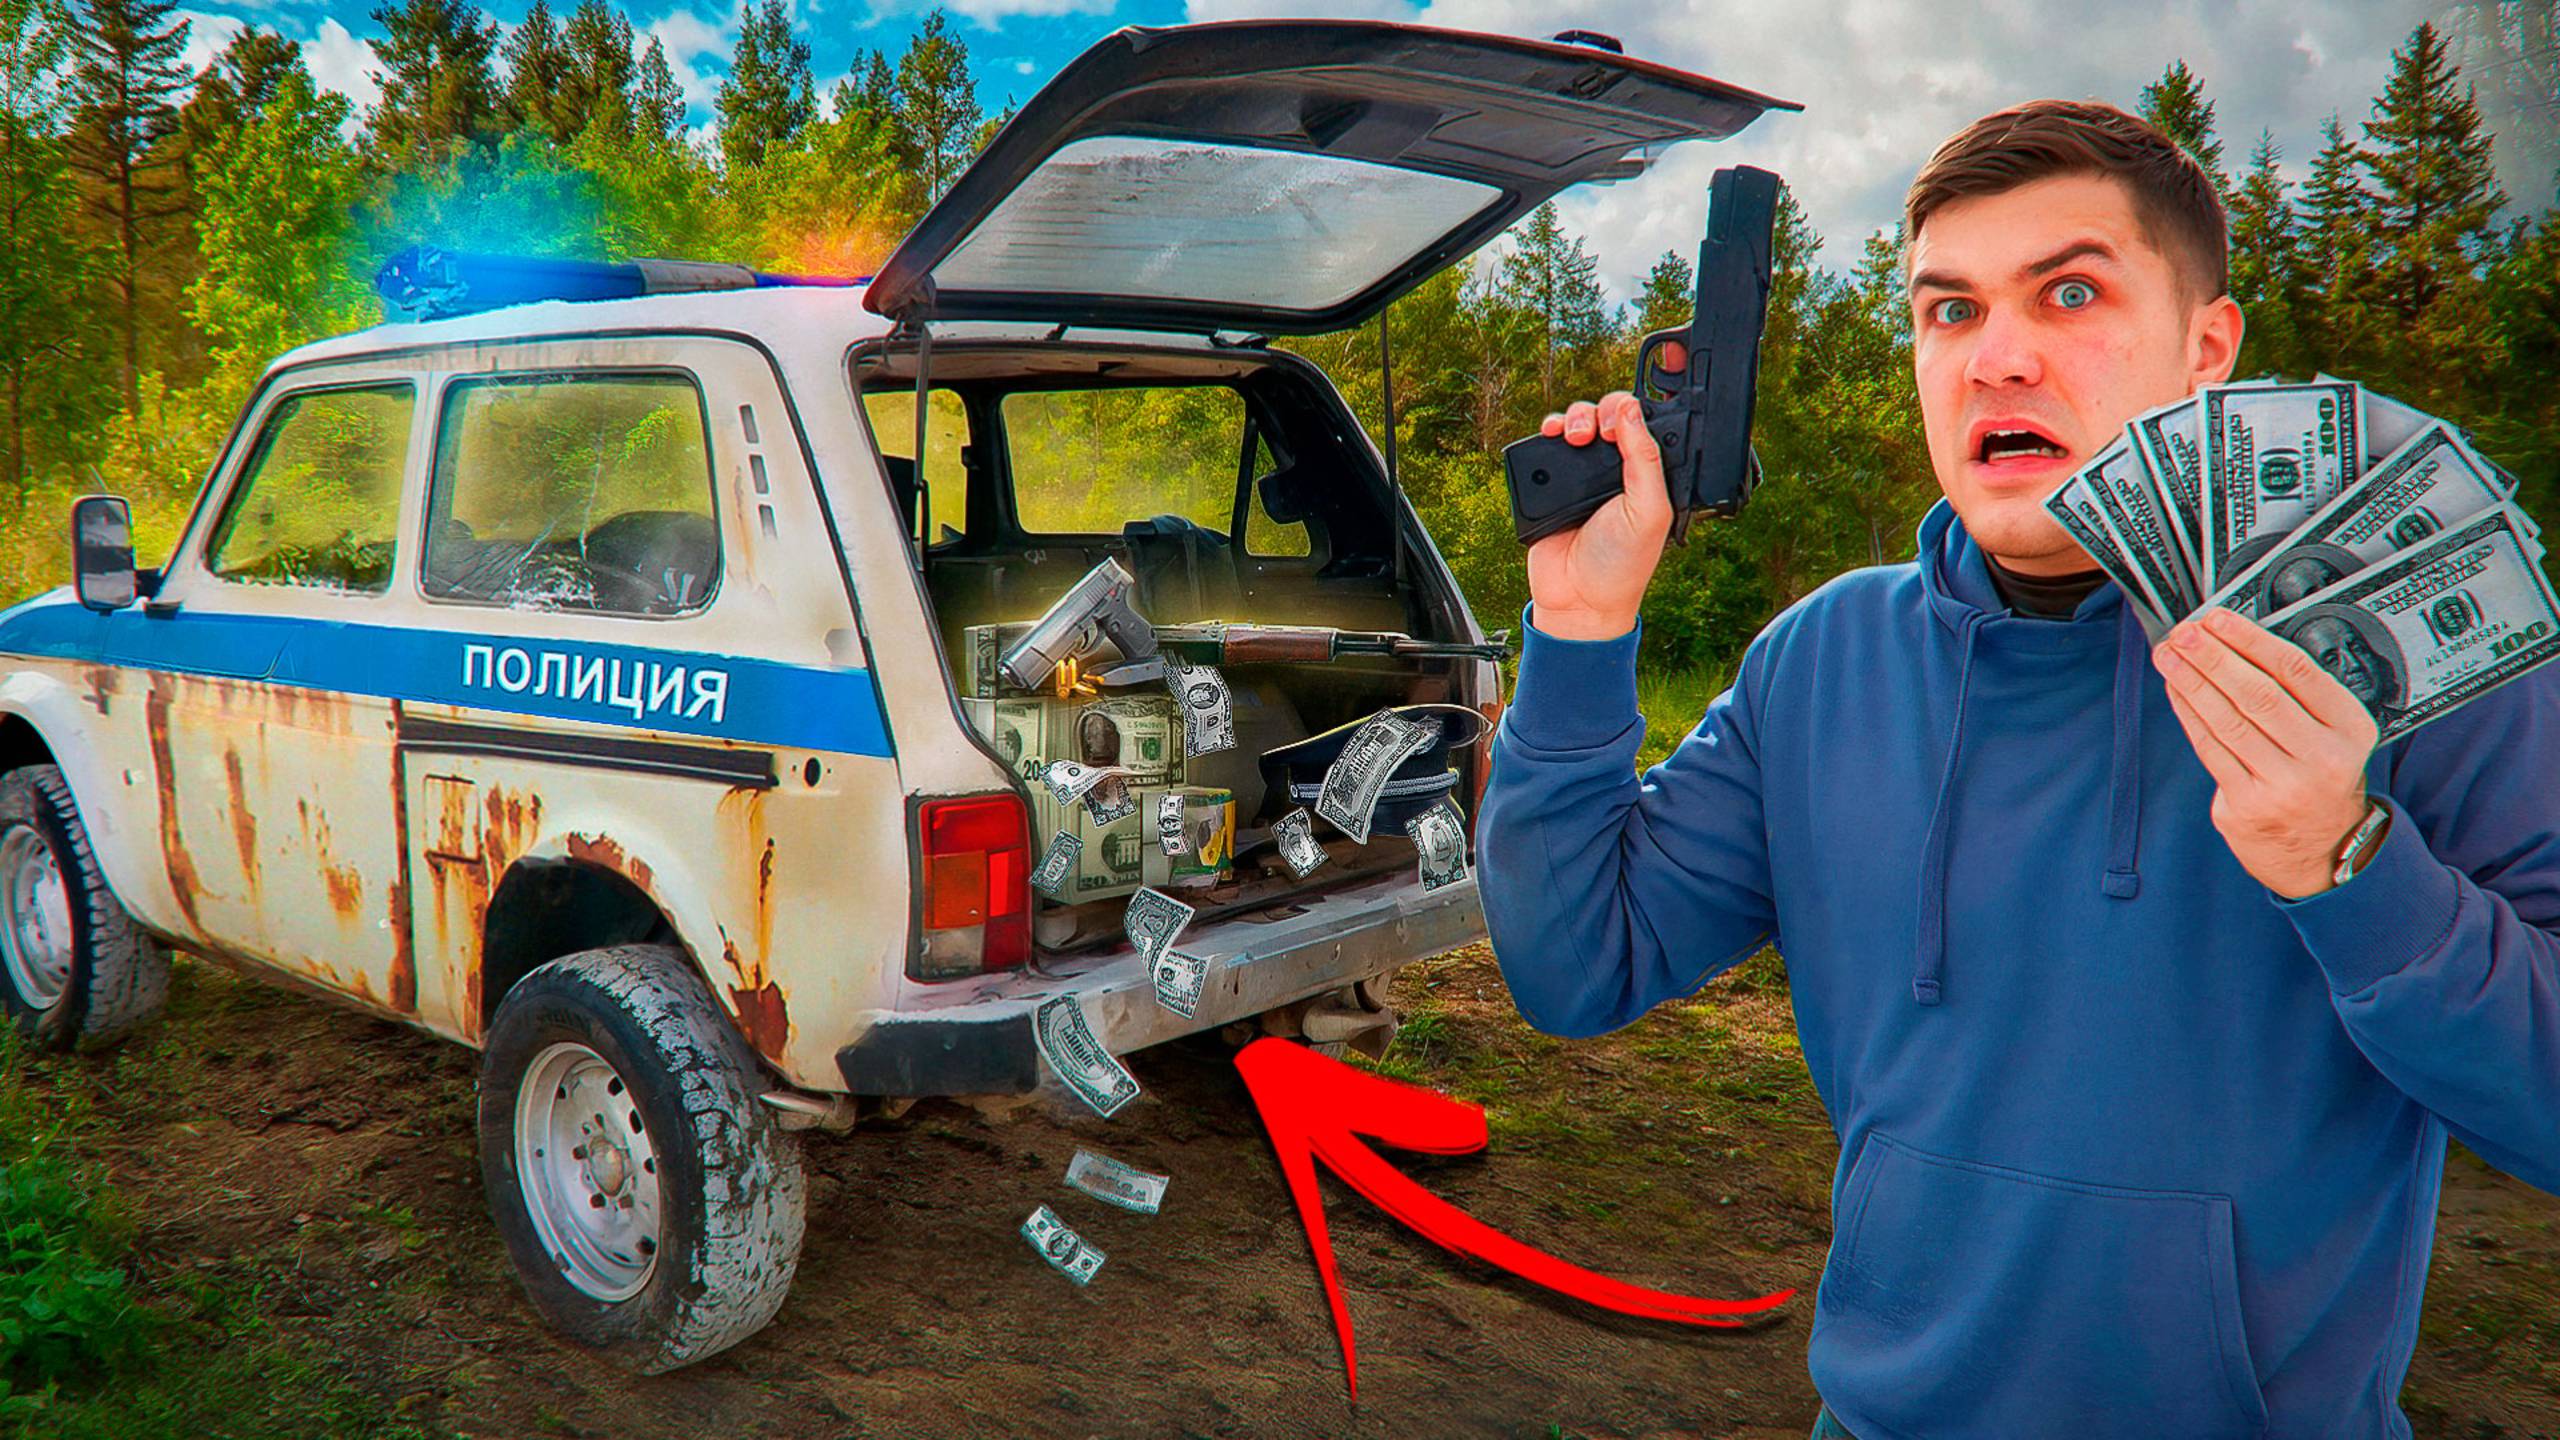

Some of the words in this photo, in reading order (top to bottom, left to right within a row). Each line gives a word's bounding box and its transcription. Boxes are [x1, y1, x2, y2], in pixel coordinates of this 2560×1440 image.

[2318, 397, 2337, 459] 100
[2488, 620, 2549, 660] 100
[462, 643, 728, 723] ПОЛИЦИЯ
[1023, 759, 1040, 781] 20
